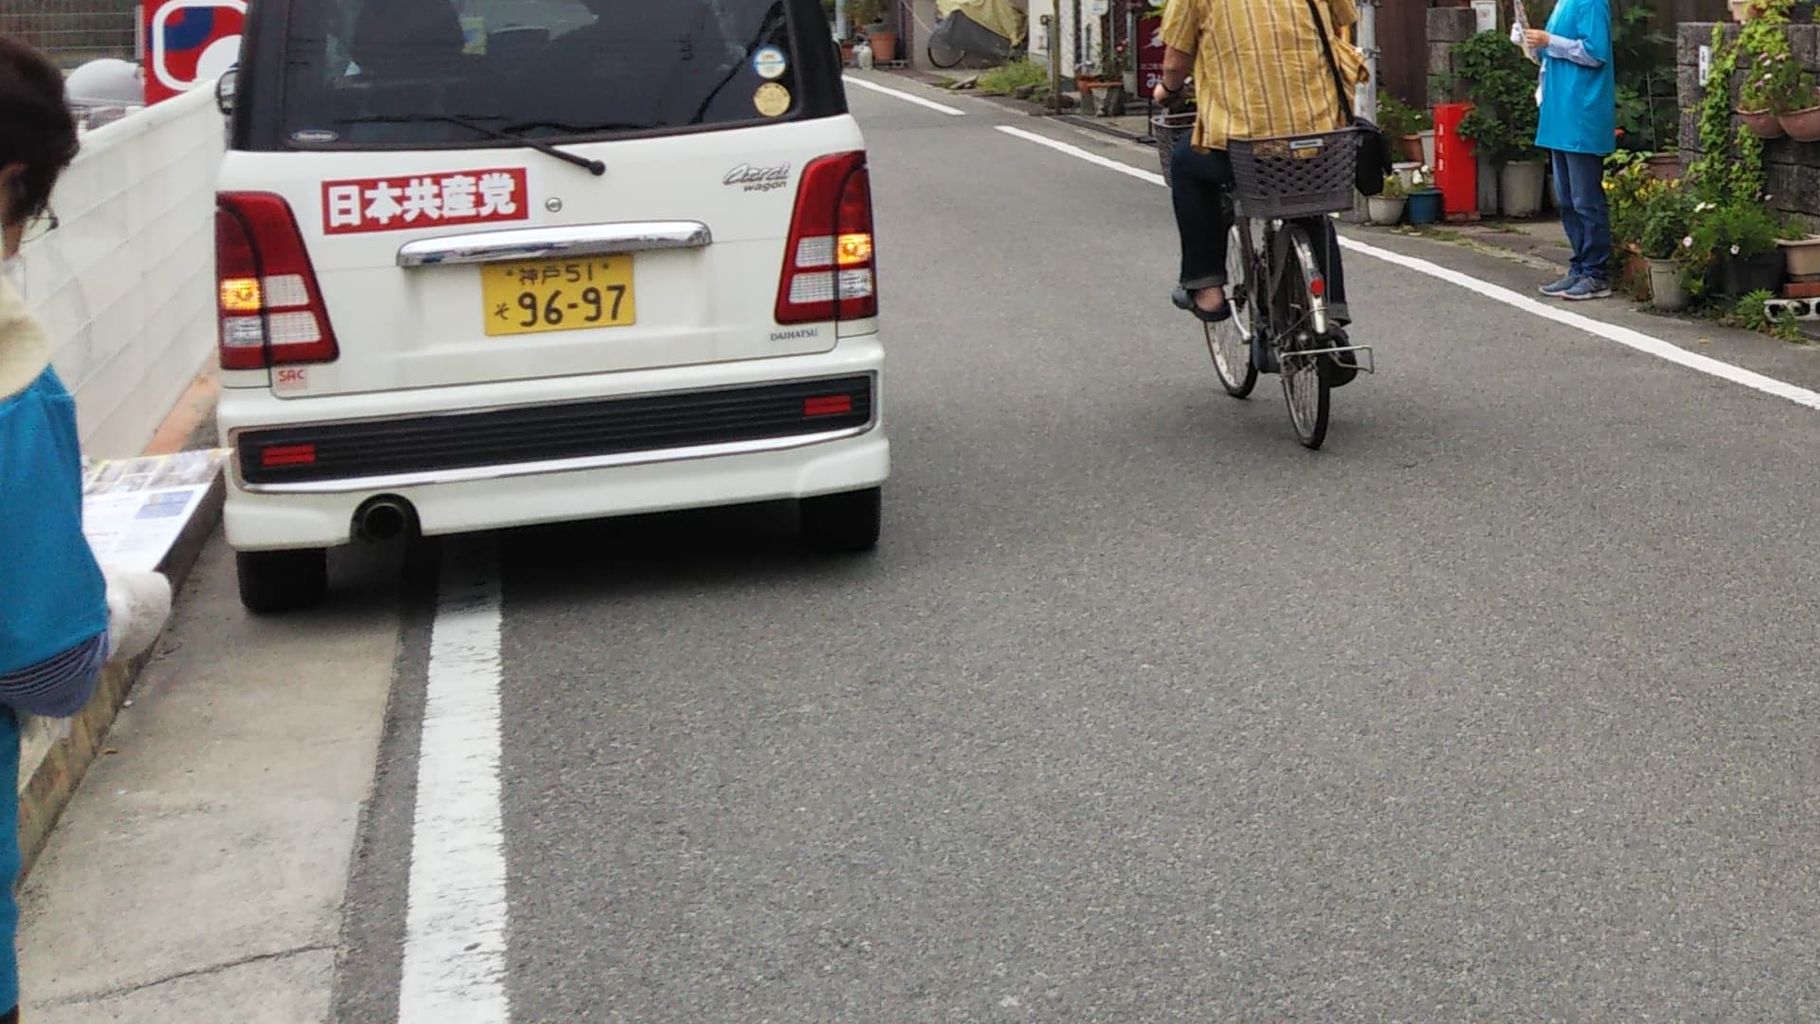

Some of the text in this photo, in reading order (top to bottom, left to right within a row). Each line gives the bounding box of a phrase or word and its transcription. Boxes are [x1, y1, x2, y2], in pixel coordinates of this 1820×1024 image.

[327, 172, 516, 227] 日本共産党
[517, 285, 627, 327] 96-97
[769, 327, 819, 341] DAIHATSU
